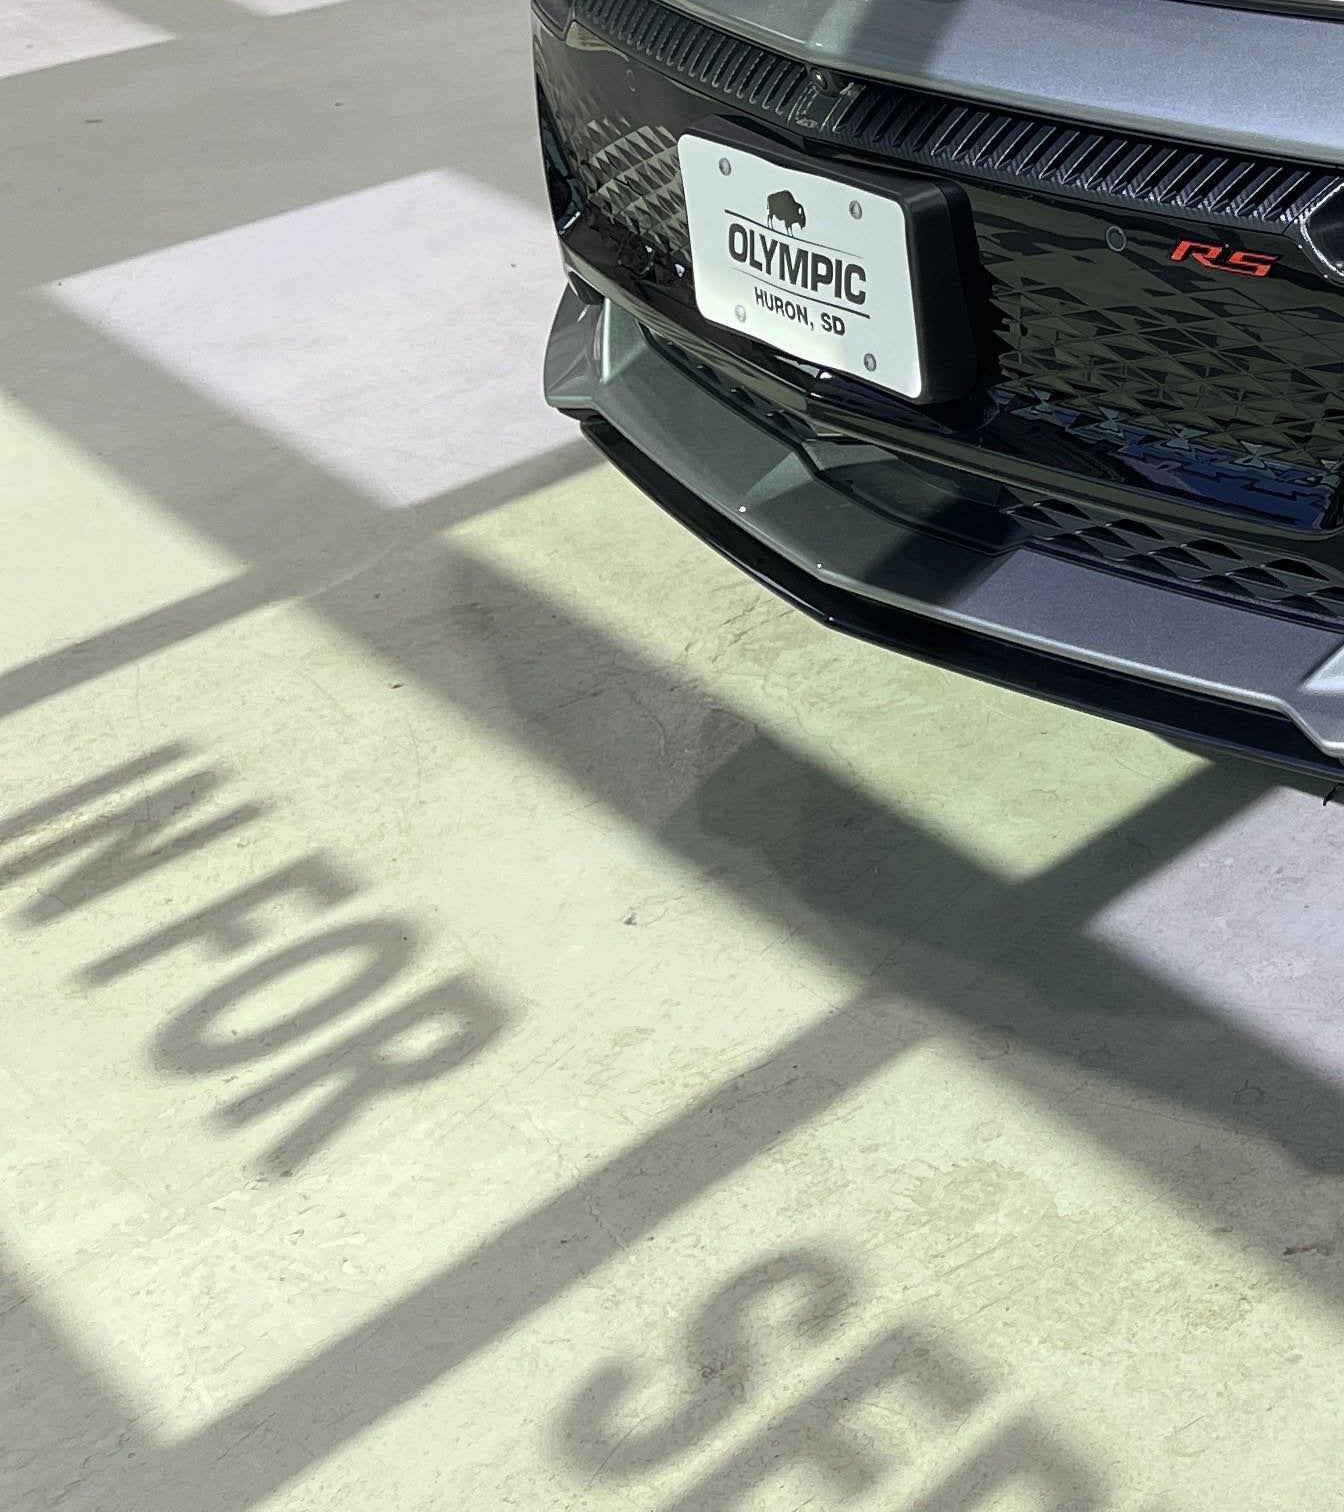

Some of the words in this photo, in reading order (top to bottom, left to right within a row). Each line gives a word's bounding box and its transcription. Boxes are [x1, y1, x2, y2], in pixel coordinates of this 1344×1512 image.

[728, 222, 867, 306] OLYMPIC
[1170, 240, 1279, 277] RS
[754, 286, 815, 331] HURON,
[820, 311, 846, 336] SD
[70, 848, 526, 1179] FOR
